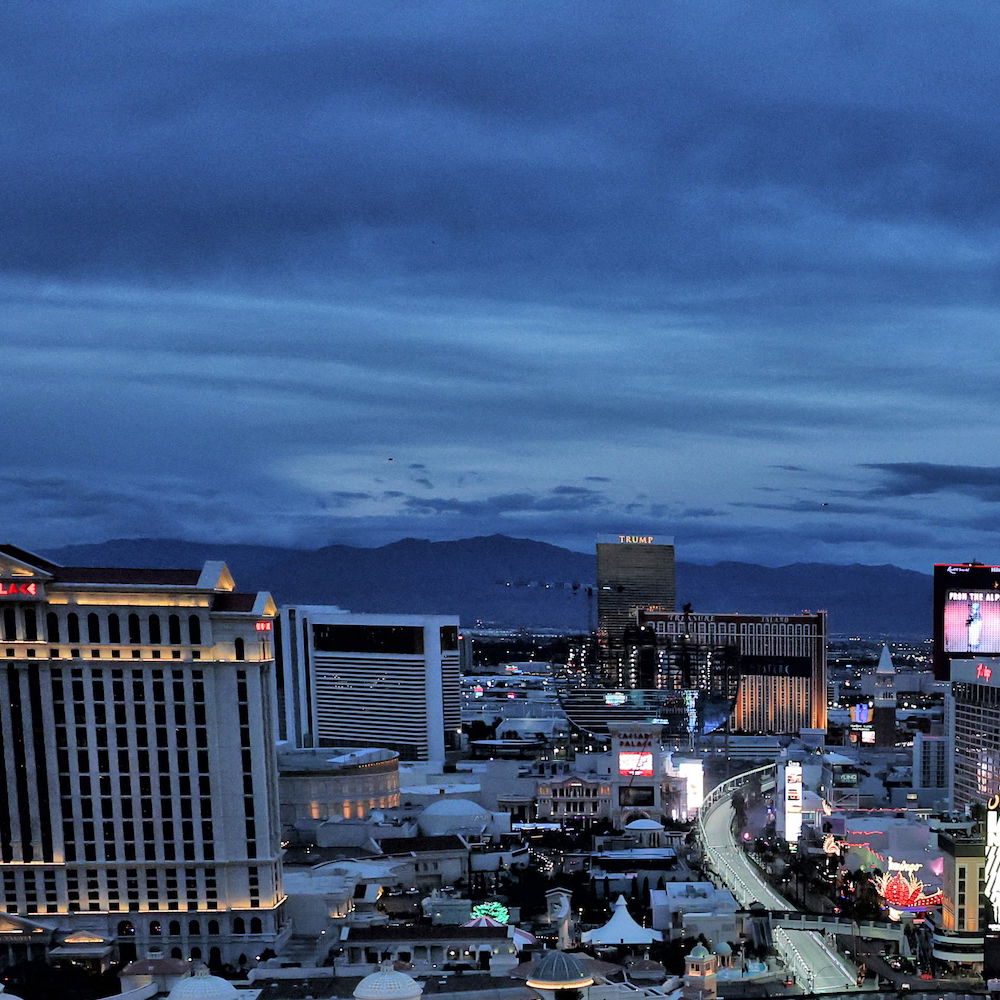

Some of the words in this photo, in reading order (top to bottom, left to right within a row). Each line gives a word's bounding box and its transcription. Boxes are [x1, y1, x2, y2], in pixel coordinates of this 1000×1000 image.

[619, 535, 654, 544] TRUMP
[949, 592, 968, 601] FROM
[969, 592, 983, 601] THE
